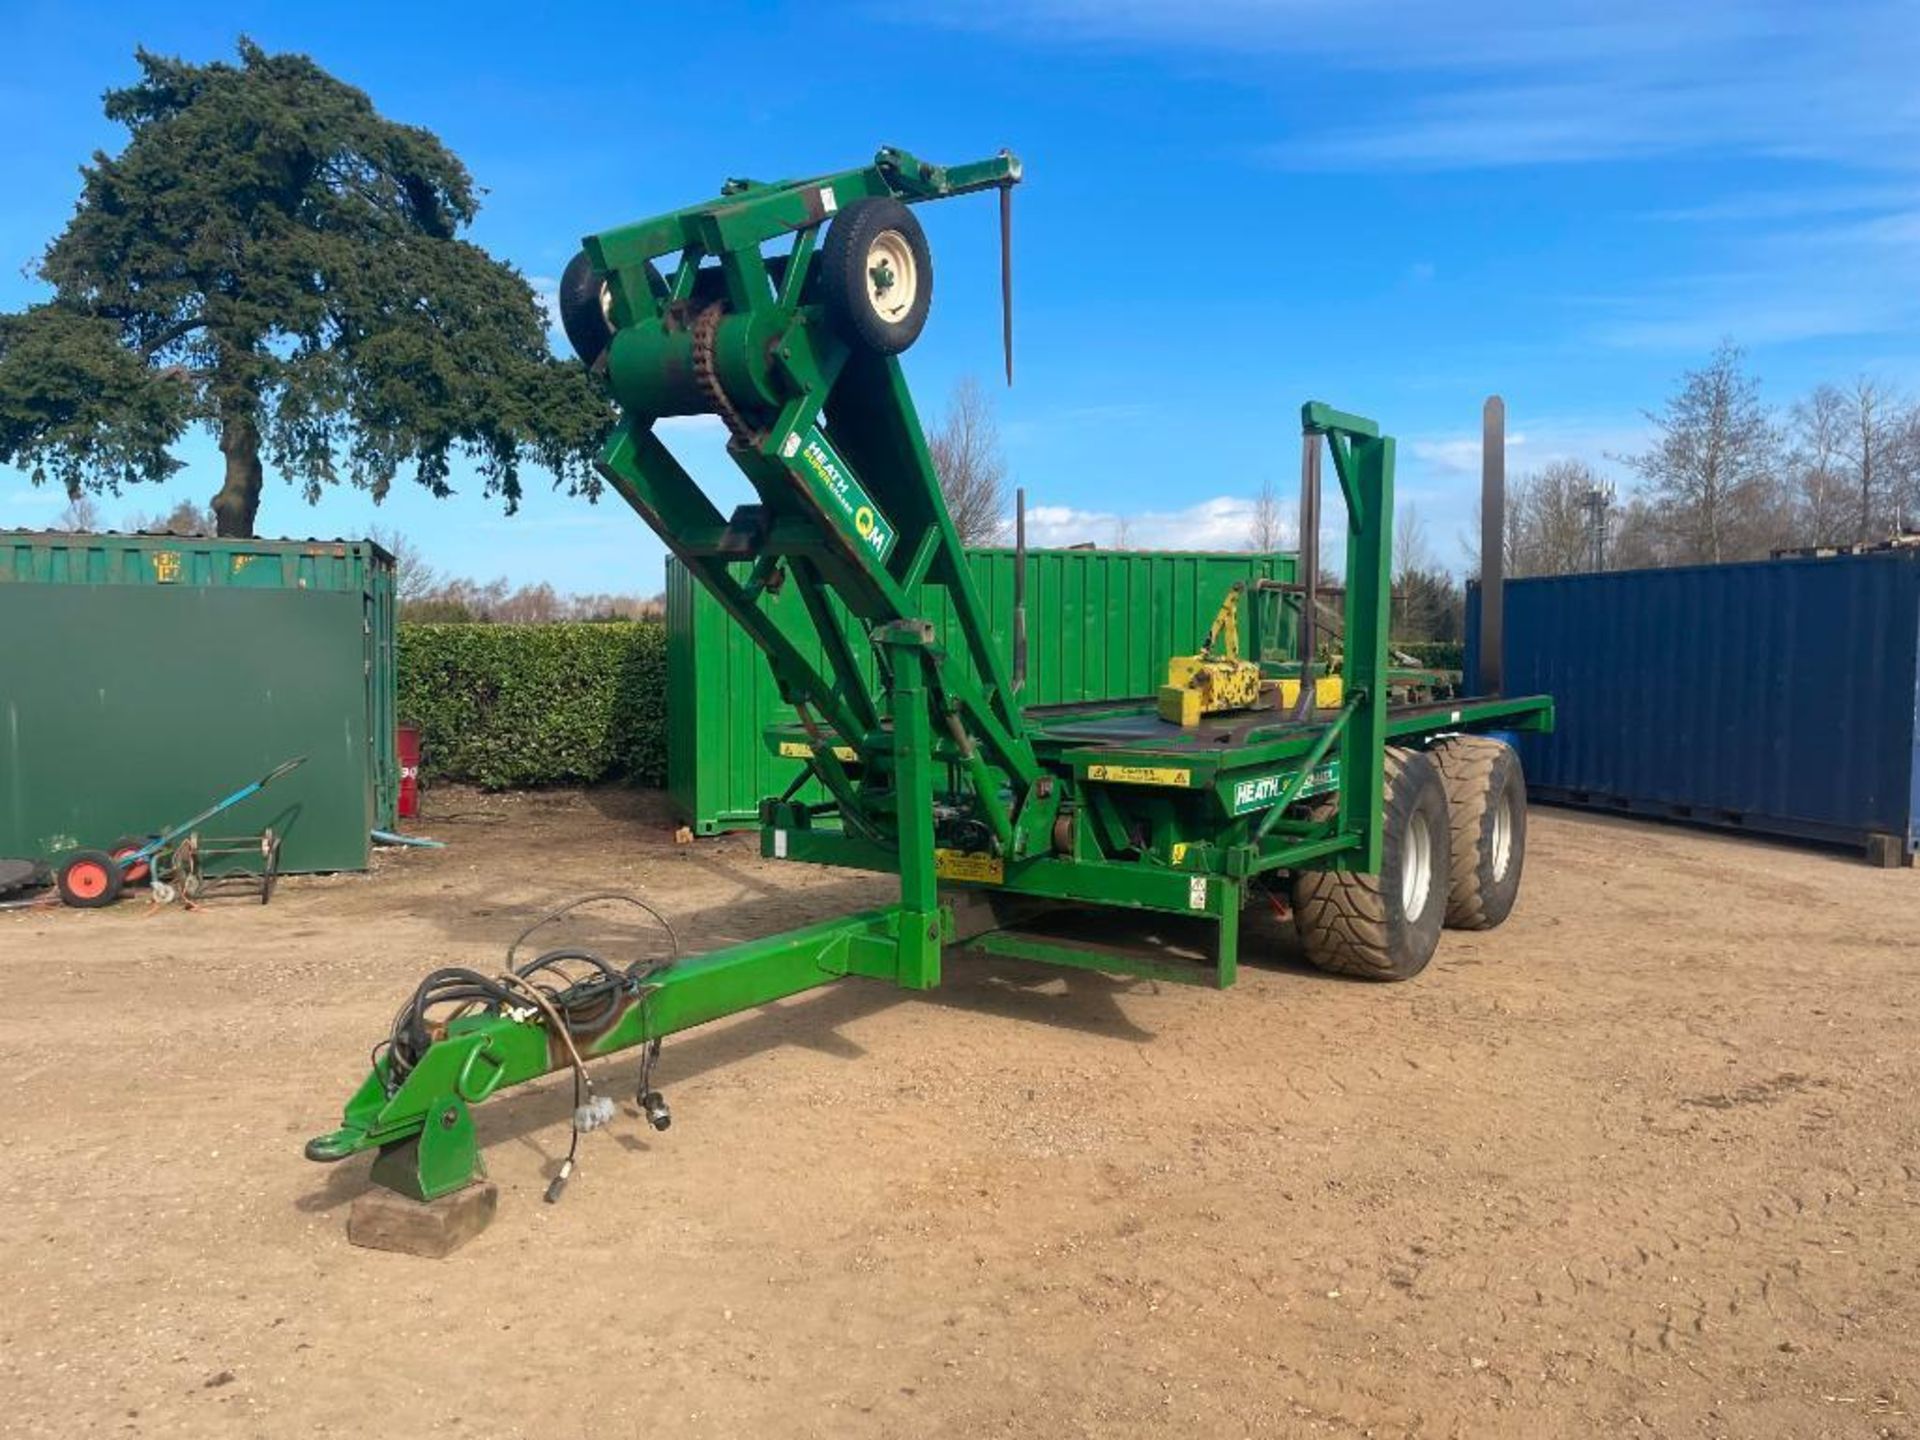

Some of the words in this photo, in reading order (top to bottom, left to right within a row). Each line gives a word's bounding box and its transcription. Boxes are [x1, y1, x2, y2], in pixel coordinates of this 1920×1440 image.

[807, 441, 849, 493] HEATH
[855, 505, 885, 552] QM
[1236, 776, 1279, 806] HEATH
